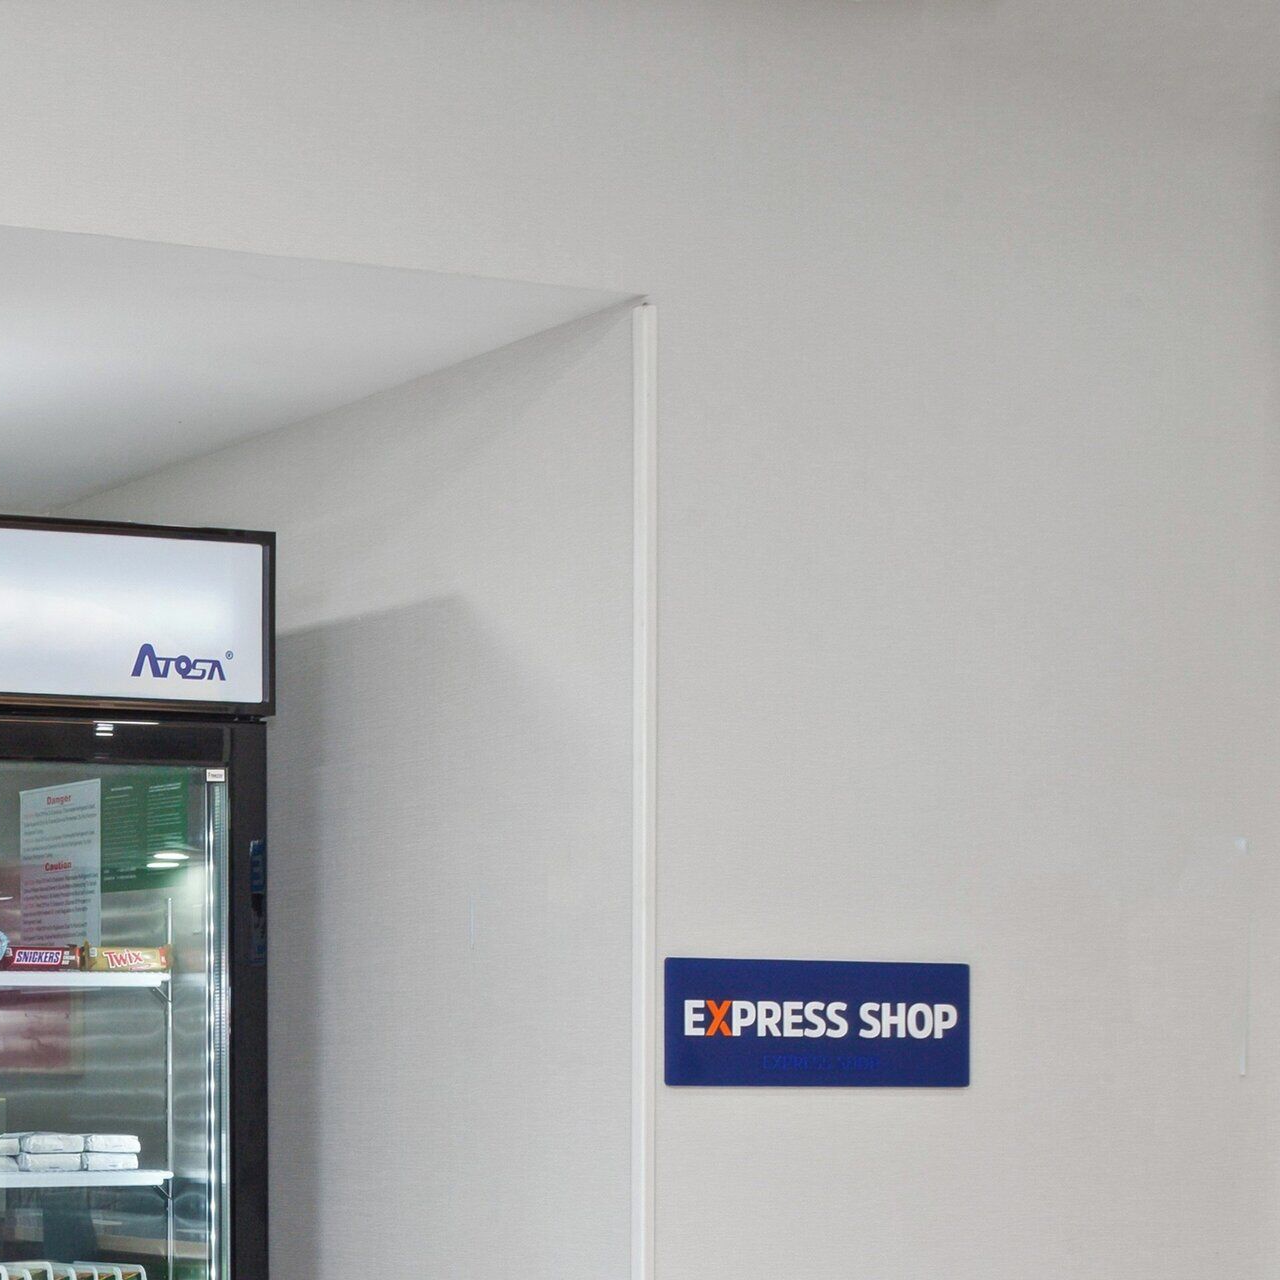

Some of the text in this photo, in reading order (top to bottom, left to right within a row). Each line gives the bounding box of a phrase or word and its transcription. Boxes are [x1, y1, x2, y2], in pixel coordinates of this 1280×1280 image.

[131, 643, 227, 682] ATOSA
[47, 794, 72, 806] Danger
[44, 861, 73, 872] Caution
[15, 950, 61, 964] SNICKERS
[683, 999, 959, 1040] EXPRESS SHOP
